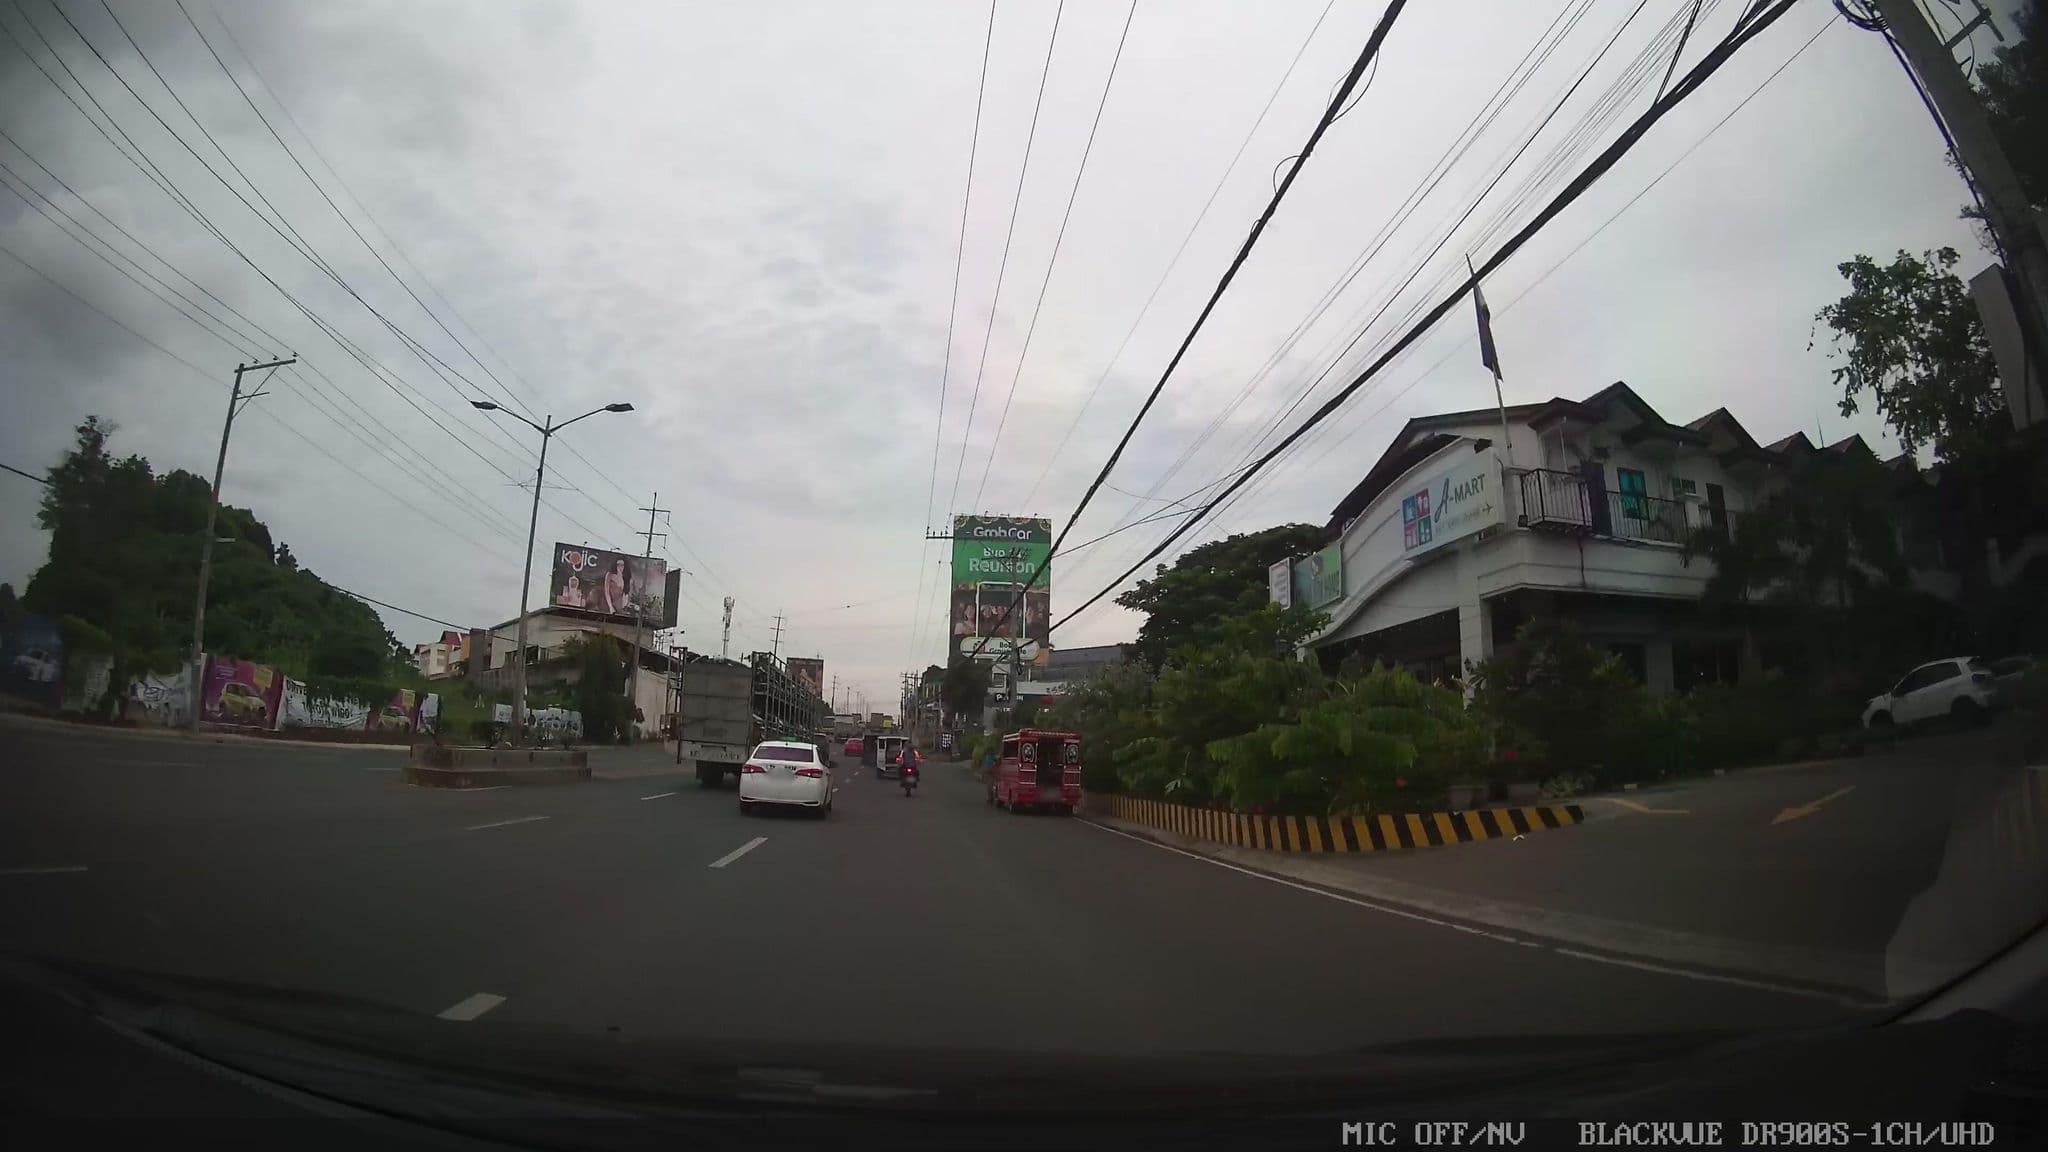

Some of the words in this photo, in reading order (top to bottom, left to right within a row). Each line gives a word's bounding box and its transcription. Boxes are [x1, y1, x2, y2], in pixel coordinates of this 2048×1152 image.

[1434, 473, 1486, 523] A-MART
[973, 526, 1032, 540] GrabCar
[968, 558, 1035, 573] Reunon
